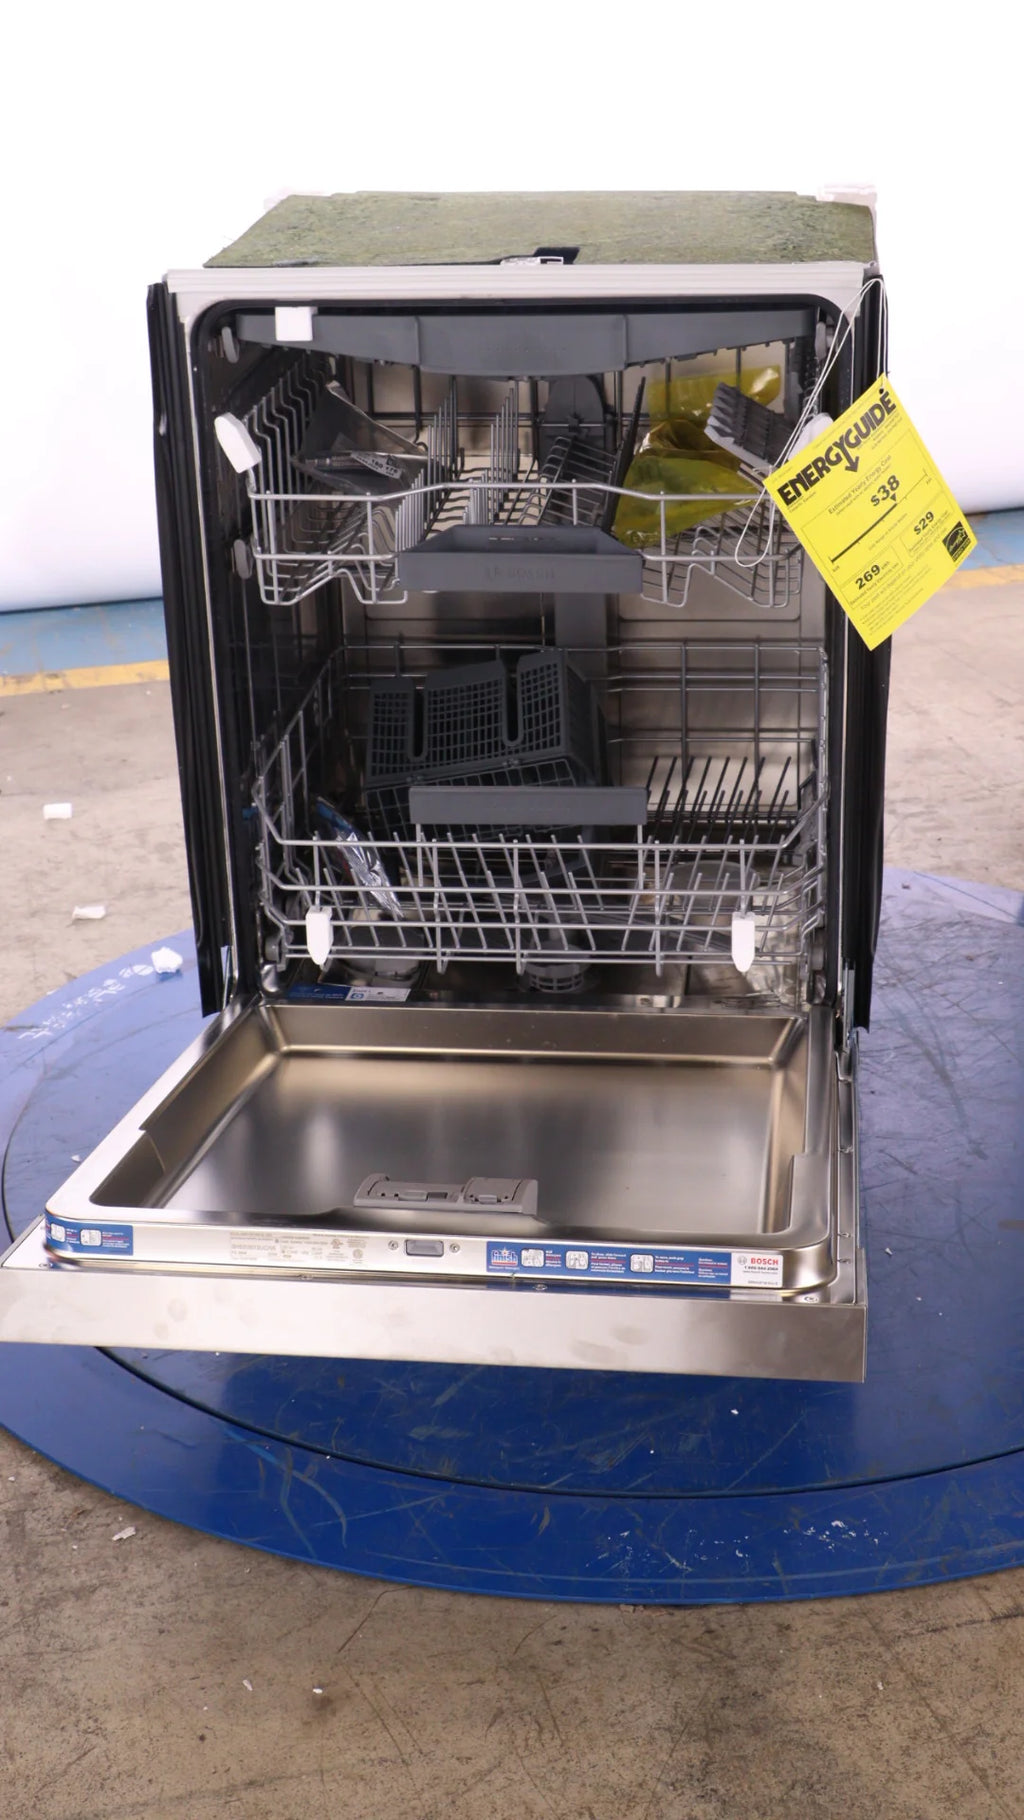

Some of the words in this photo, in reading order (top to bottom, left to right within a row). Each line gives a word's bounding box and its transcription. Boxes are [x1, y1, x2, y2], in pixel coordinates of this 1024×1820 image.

[777, 390, 897, 506] ENERGYGUIDE
[870, 474, 900, 507] $38
[913, 511, 935, 535] $29
[855, 564, 880, 590] 269
[751, 1258, 778, 1266] BOSCH
